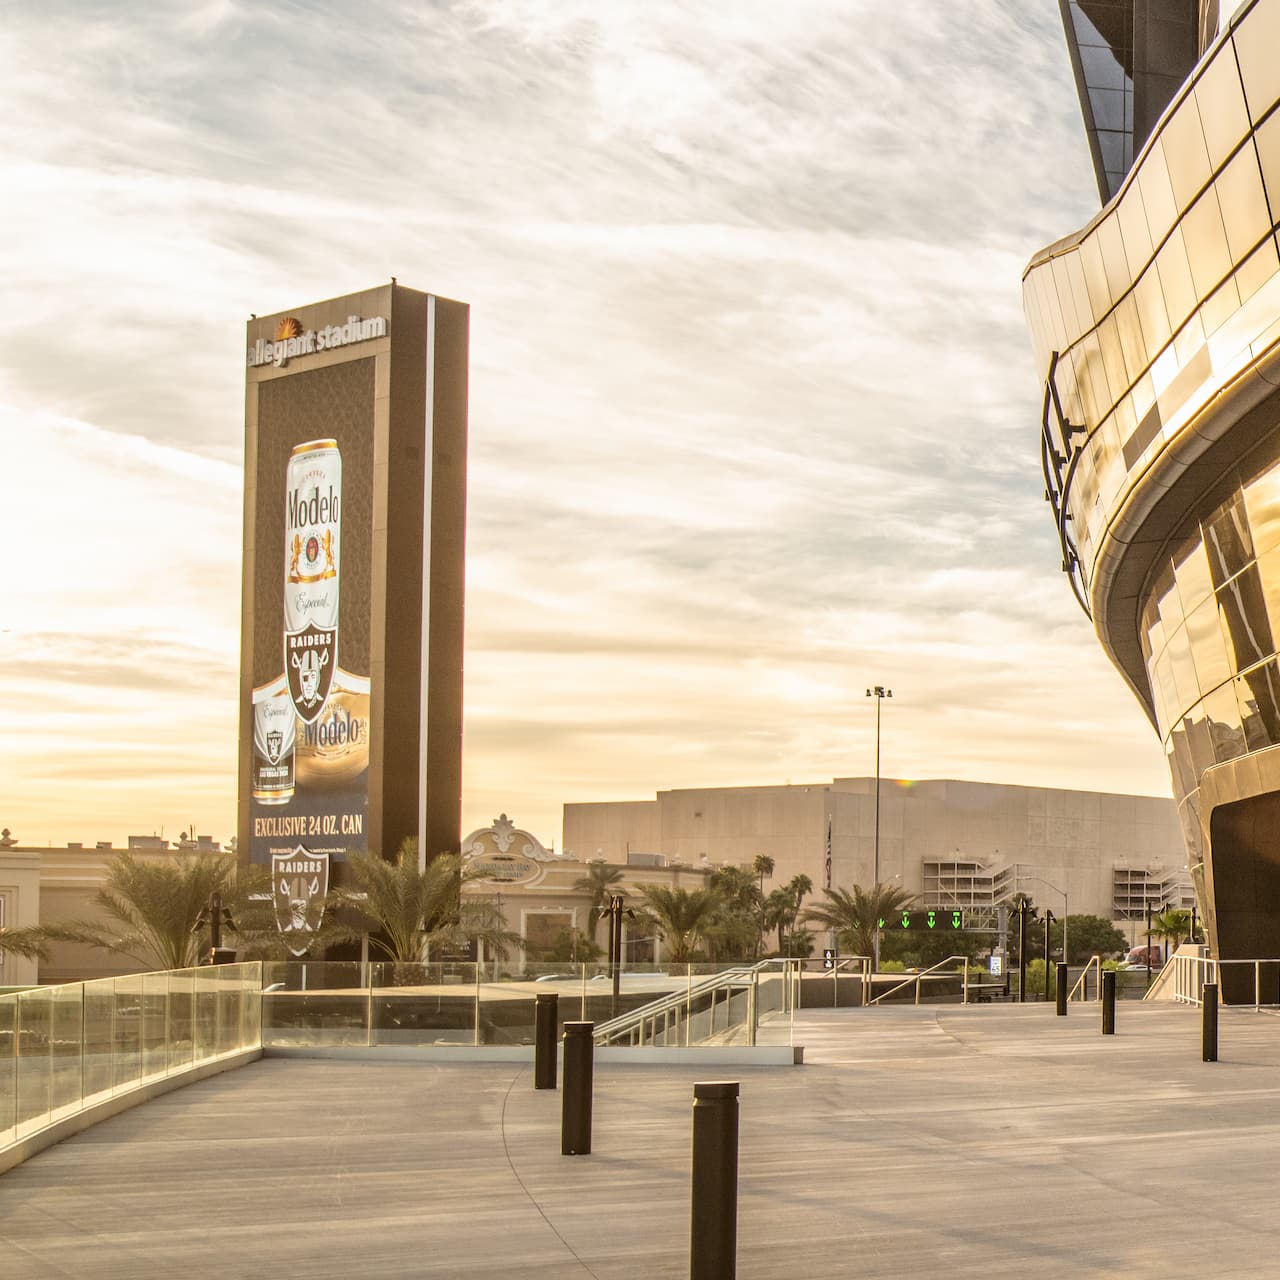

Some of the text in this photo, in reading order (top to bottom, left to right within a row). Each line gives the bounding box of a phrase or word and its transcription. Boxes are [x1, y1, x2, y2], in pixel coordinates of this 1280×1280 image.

[248, 315, 387, 368] allegiant stadium
[288, 484, 339, 530] Modelo
[290, 632, 332, 649] RAIDERS
[304, 711, 359, 747] Modelo
[255, 813, 363, 838] EXCLUSIVE 24 OZ. CAN
[278, 860, 322, 874] RAIDERS
